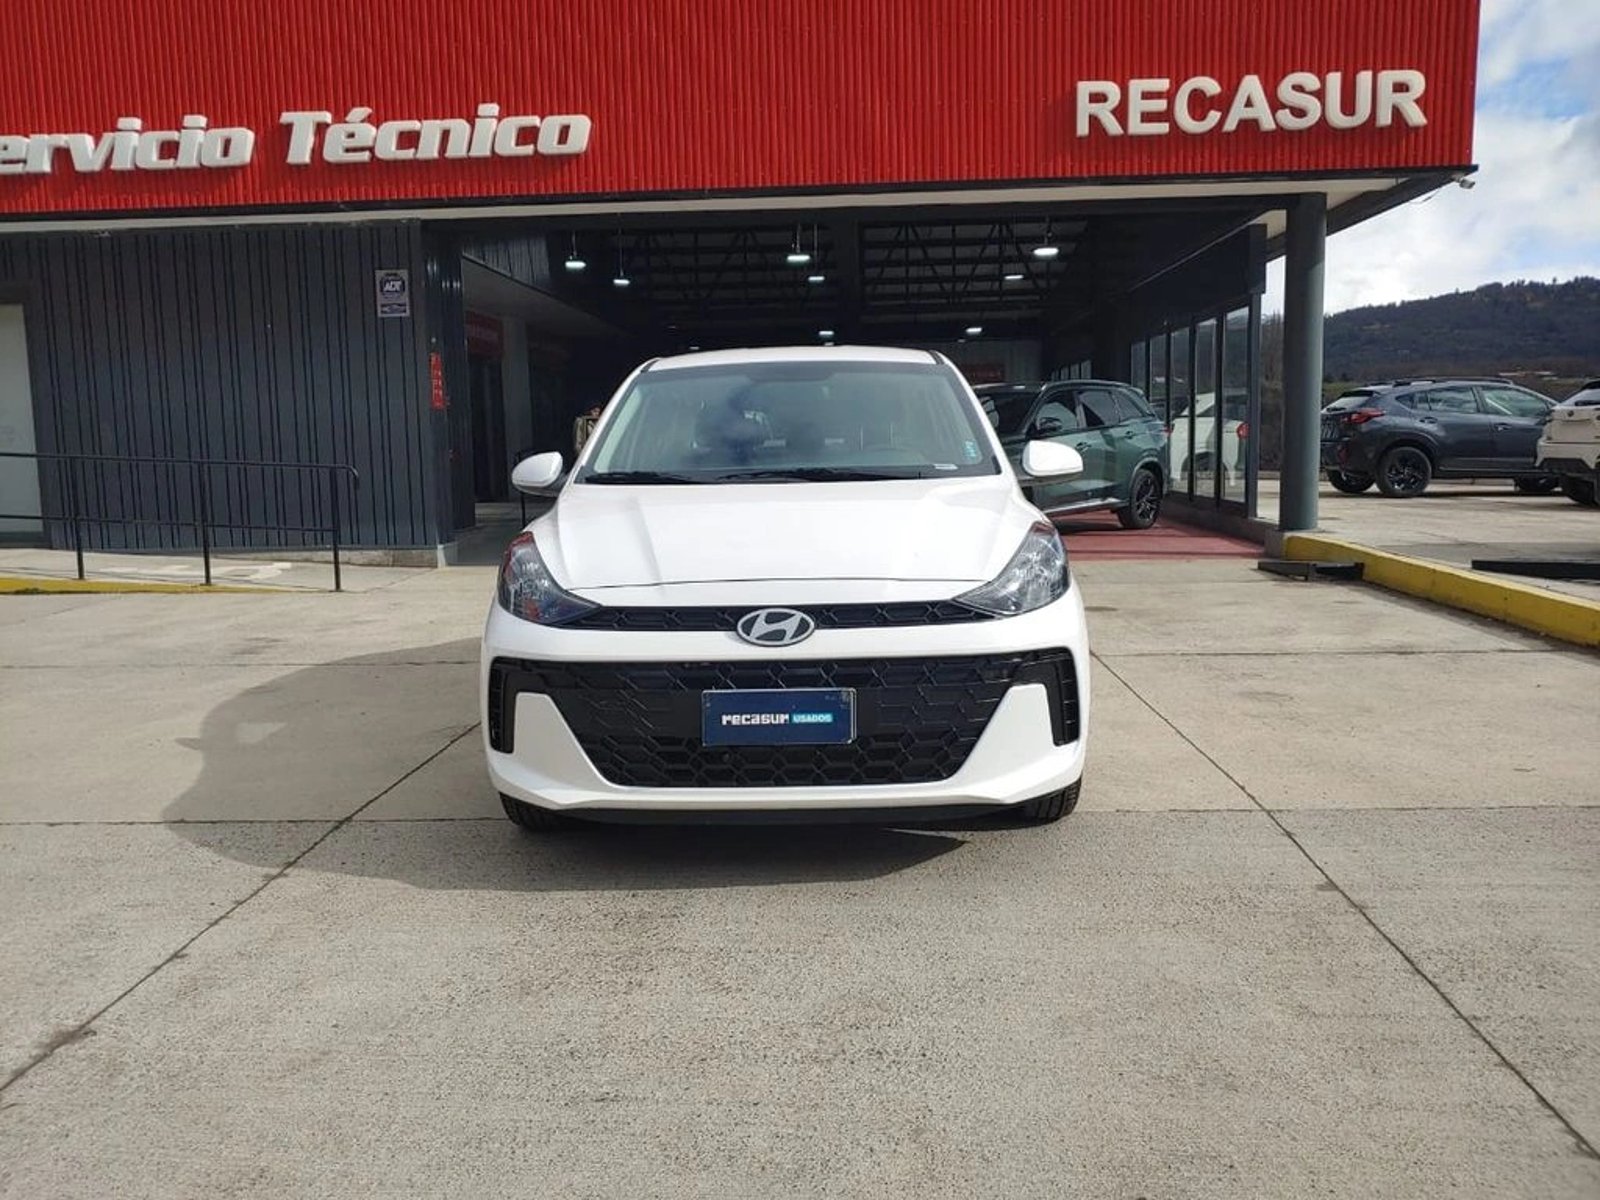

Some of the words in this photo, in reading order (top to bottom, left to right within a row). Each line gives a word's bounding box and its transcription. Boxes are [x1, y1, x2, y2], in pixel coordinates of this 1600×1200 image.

[280, 102, 592, 164] Técnico
[1076, 69, 1428, 138] RECASUR
[721, 713, 790, 726] recasur
[792, 713, 833, 724] USADOS
